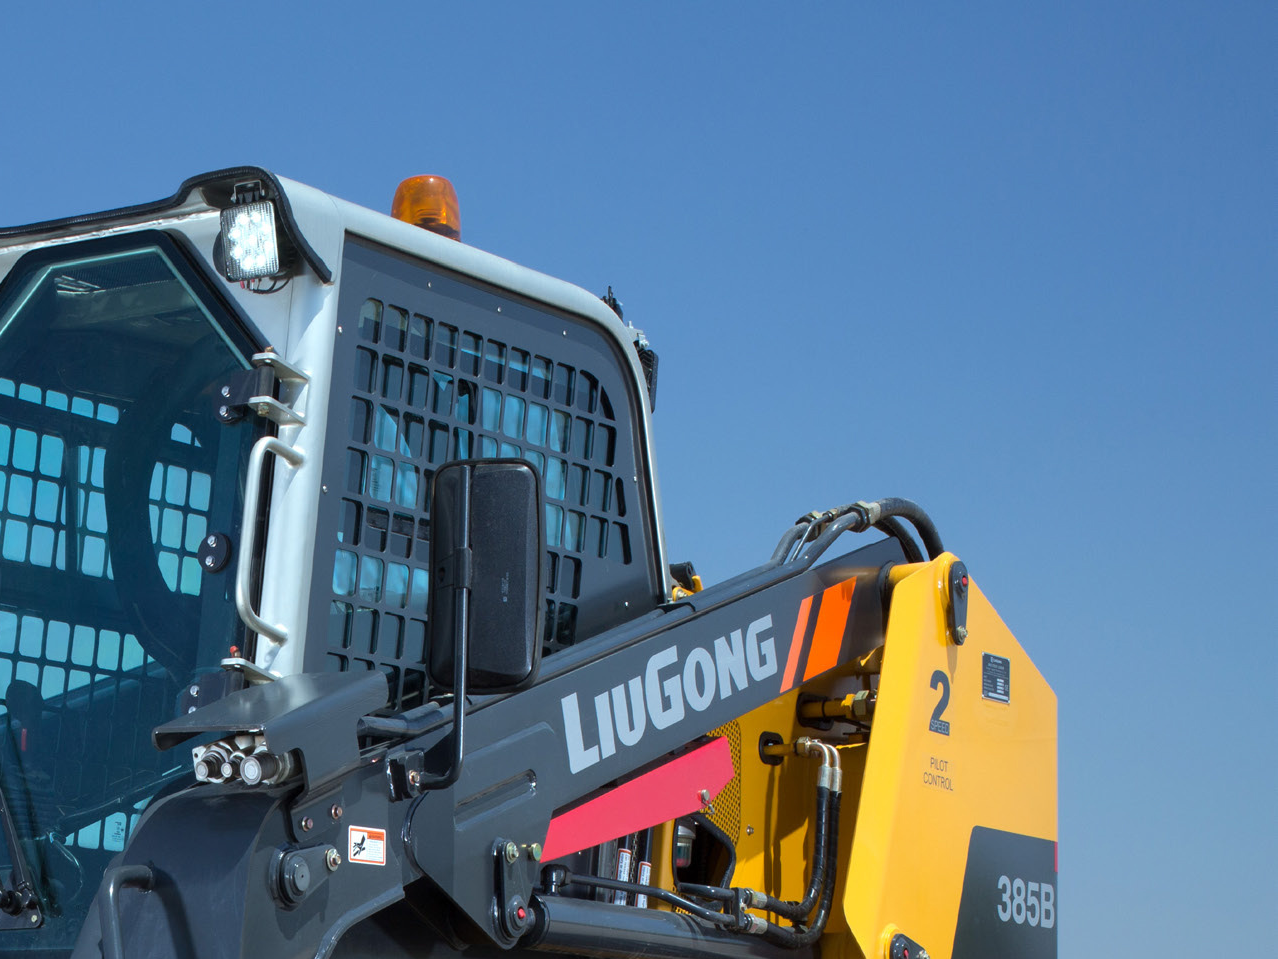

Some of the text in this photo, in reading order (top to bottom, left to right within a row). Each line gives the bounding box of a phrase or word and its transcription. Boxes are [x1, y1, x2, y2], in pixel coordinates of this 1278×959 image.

[929, 669, 950, 736] 2
[930, 719, 950, 735] SPEED
[930, 757, 949, 772] PILOT
[923, 772, 954, 791] CONTROL
[997, 874, 1055, 929] 385B
